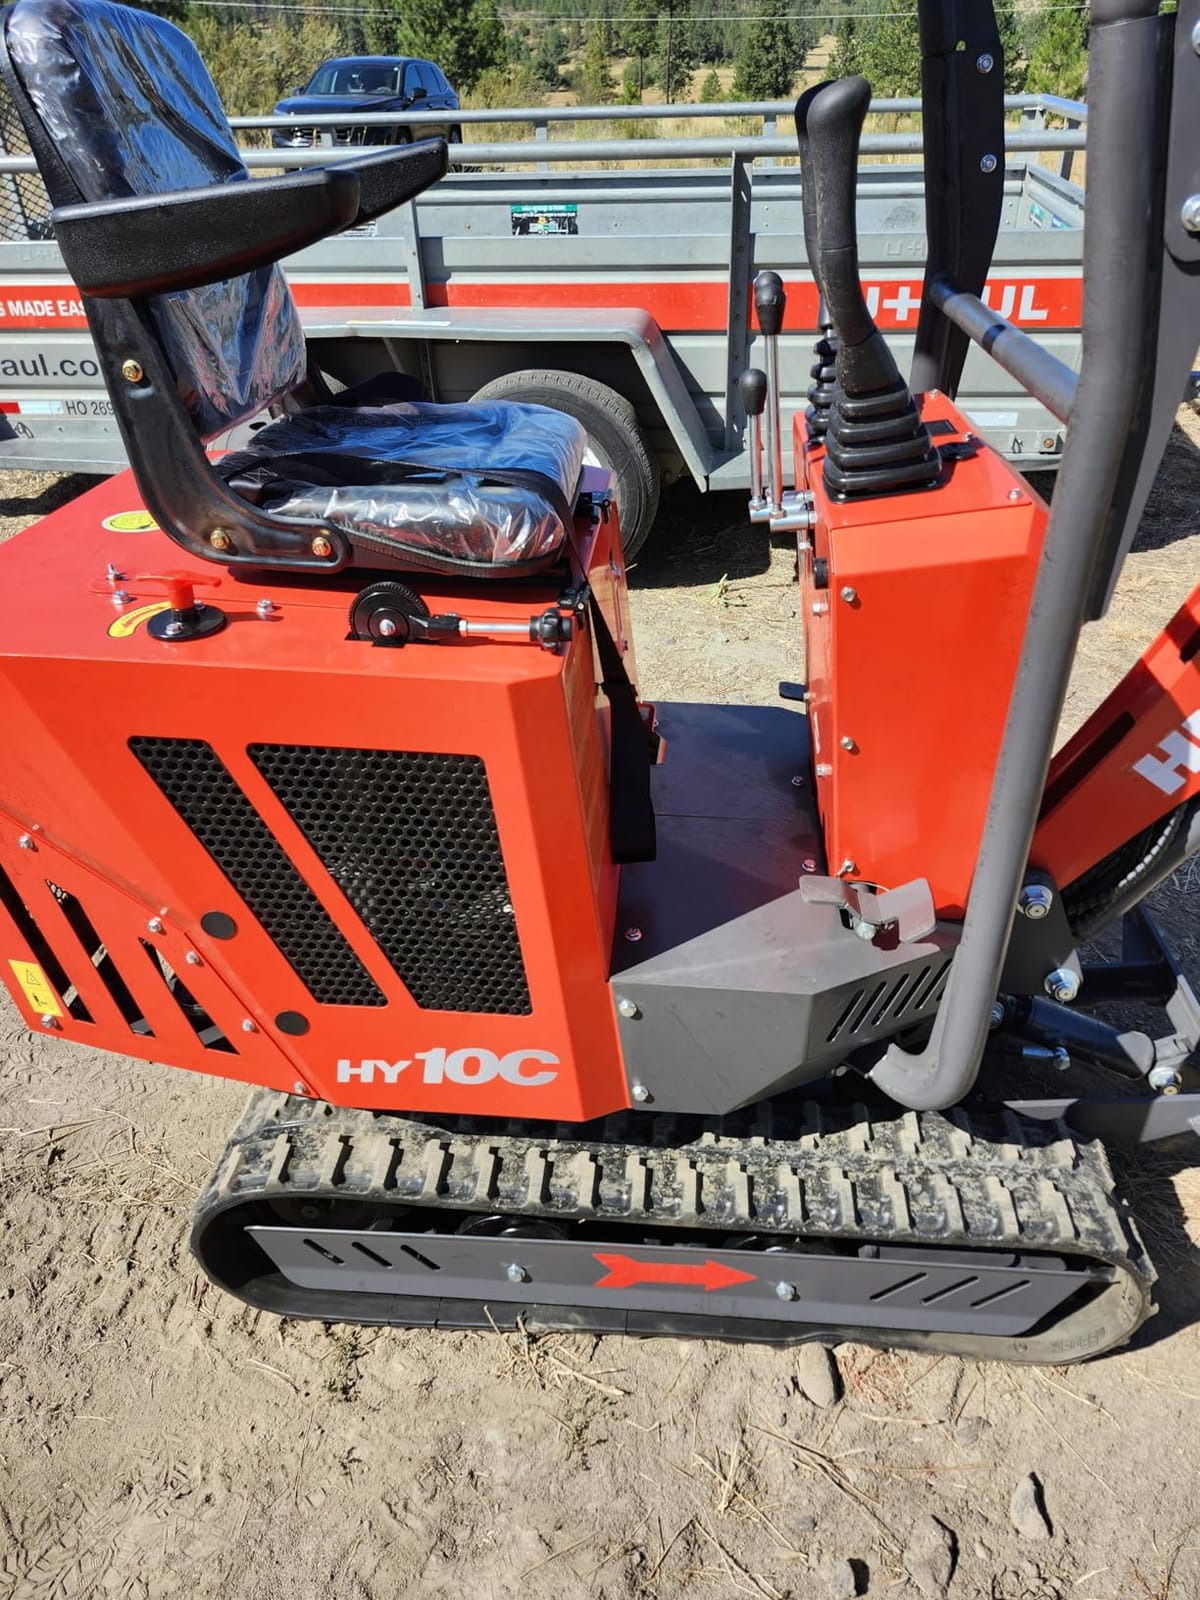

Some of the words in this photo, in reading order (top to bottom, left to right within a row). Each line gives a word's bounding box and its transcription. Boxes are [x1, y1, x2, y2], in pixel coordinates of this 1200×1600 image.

[7, 299, 56, 317] MADE
[0, 353, 99, 377] aul.co
[65, 400, 88, 416] HO
